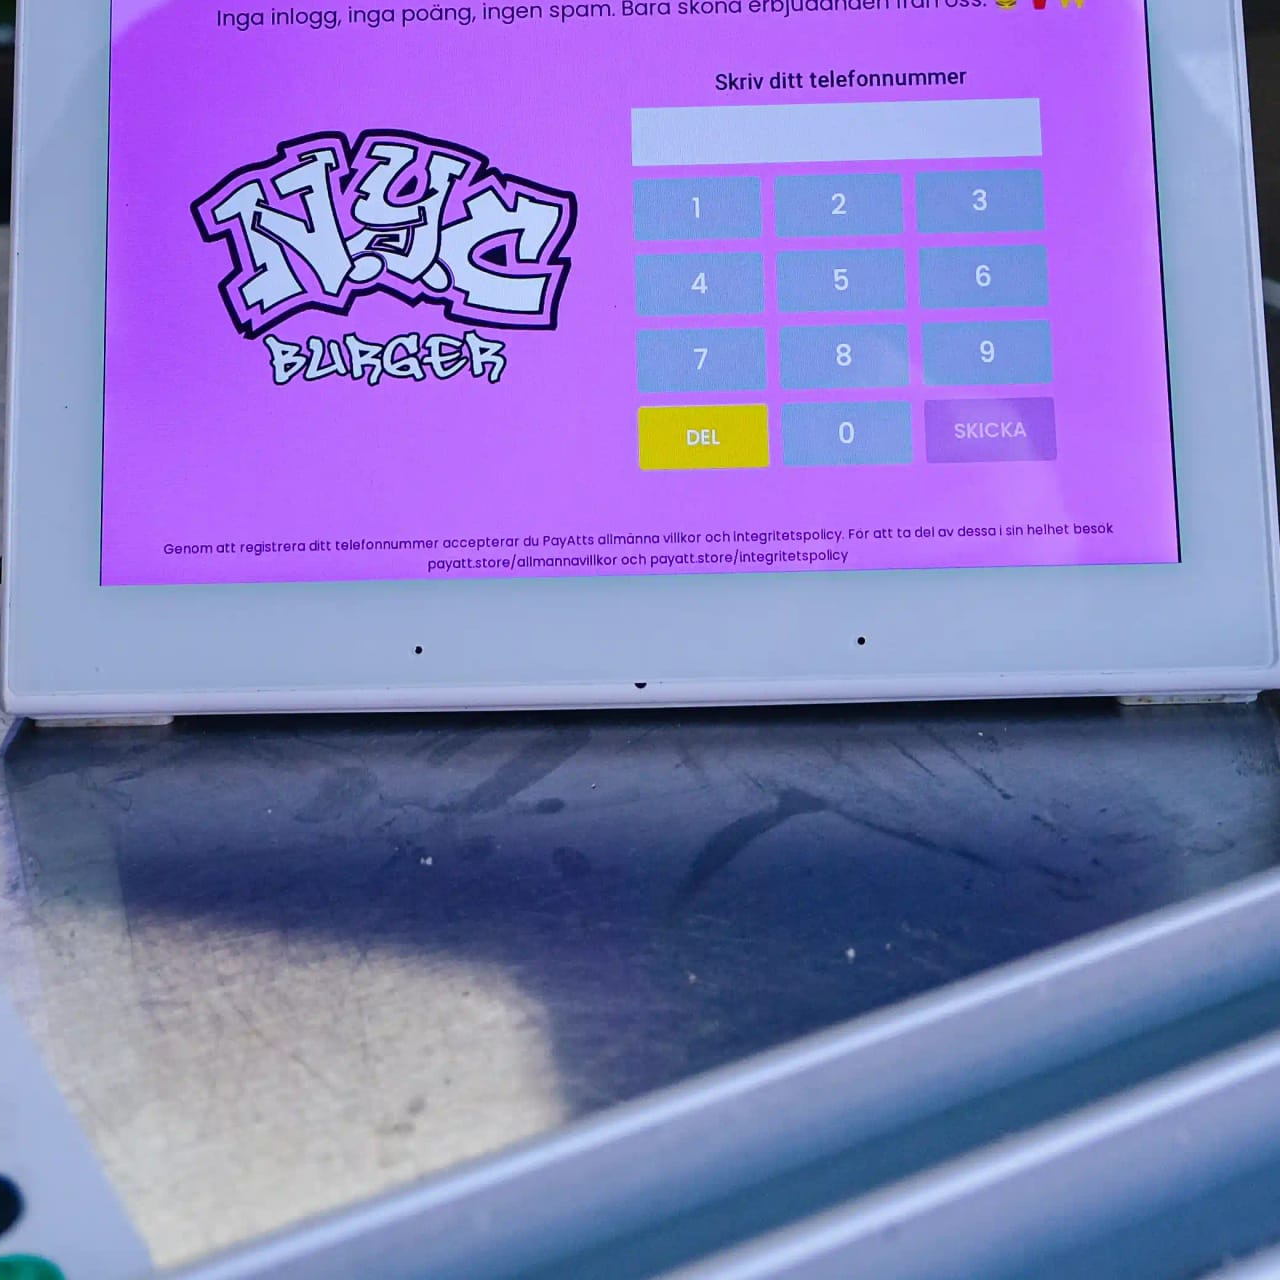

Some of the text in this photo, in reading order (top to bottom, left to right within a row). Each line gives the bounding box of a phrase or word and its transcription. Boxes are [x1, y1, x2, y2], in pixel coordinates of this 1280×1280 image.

[217, 9, 264, 32] Inga
[271, 7, 342, 30] inlogg,
[348, 5, 395, 29] inga
[401, 3, 476, 28] poäng,
[482, 2, 543, 25] ingen
[549, 3, 616, 24] spam.
[621, 0, 671, 17] Bara
[715, 69, 967, 91] Skriv ditt telefonnummer
[691, 189, 988, 219] 1 2 3
[190, 128, 578, 339] NYC
[690, 264, 992, 294] 4 5 6
[263, 331, 507, 385] BURGER
[693, 340, 996, 371] 7 8 9
[685, 421, 1028, 447] DEL 0 SKICKA
[163, 522, 1114, 556] Genom att registrera ditt telefonnummer accepterar du PayAtts allmänna villkor och integritetspolicy. För att ta del av dessa i sin helhet besök
[427, 548, 849, 573] payatt.store/allmannavillkor och payatt.store/integritetspolicy
